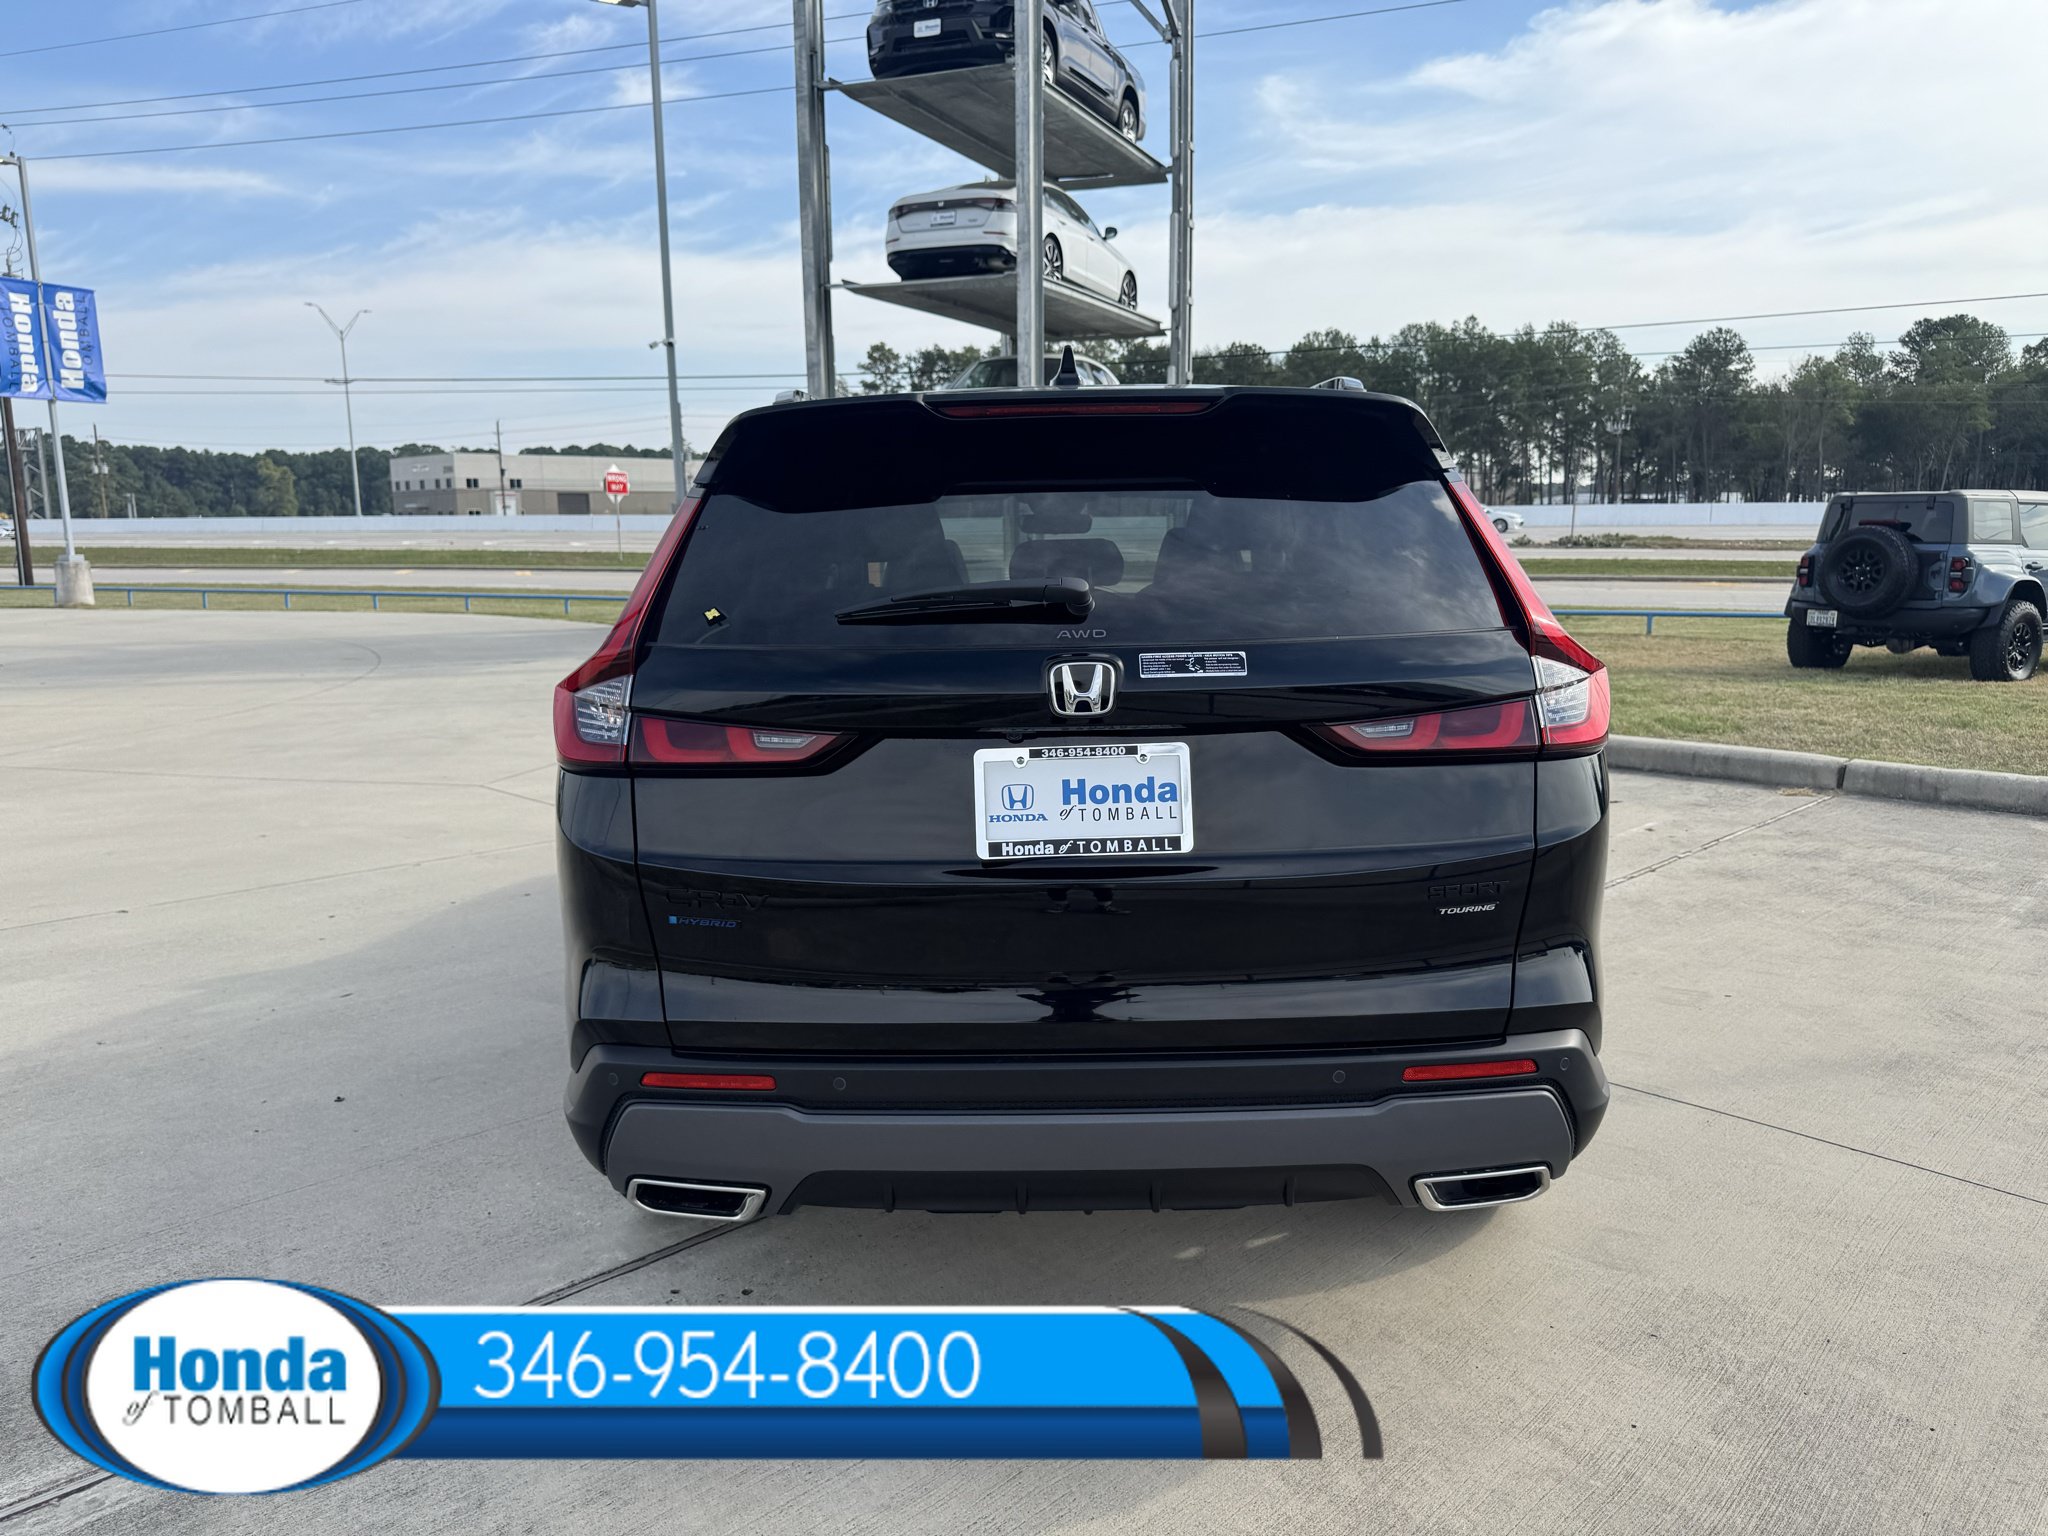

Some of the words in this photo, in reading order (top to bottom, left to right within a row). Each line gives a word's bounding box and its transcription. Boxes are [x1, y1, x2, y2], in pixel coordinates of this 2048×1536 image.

[8, 292, 39, 393] Honda
[53, 291, 84, 389] Honda
[76, 295, 94, 377] TOMBALL
[0, 305, 20, 390] TOMBALL
[607, 474, 627, 482] WRONG
[610, 483, 624, 491] WAY
[1057, 629, 1107, 639] AWD
[1041, 746, 1127, 758] 346-954-8400
[1061, 776, 1178, 805] Honda
[988, 814, 1048, 823] HONDA
[1059, 805, 1078, 821] of
[1078, 806, 1178, 822] TOMBALL
[1001, 842, 1055, 856] Honda
[1058, 840, 1073, 855] of
[1077, 838, 1173, 853] TOMBALL
[1427, 881, 1510, 899] SPORT
[1439, 903, 1497, 915] TOURING
[678, 917, 738, 928] HYBRID
